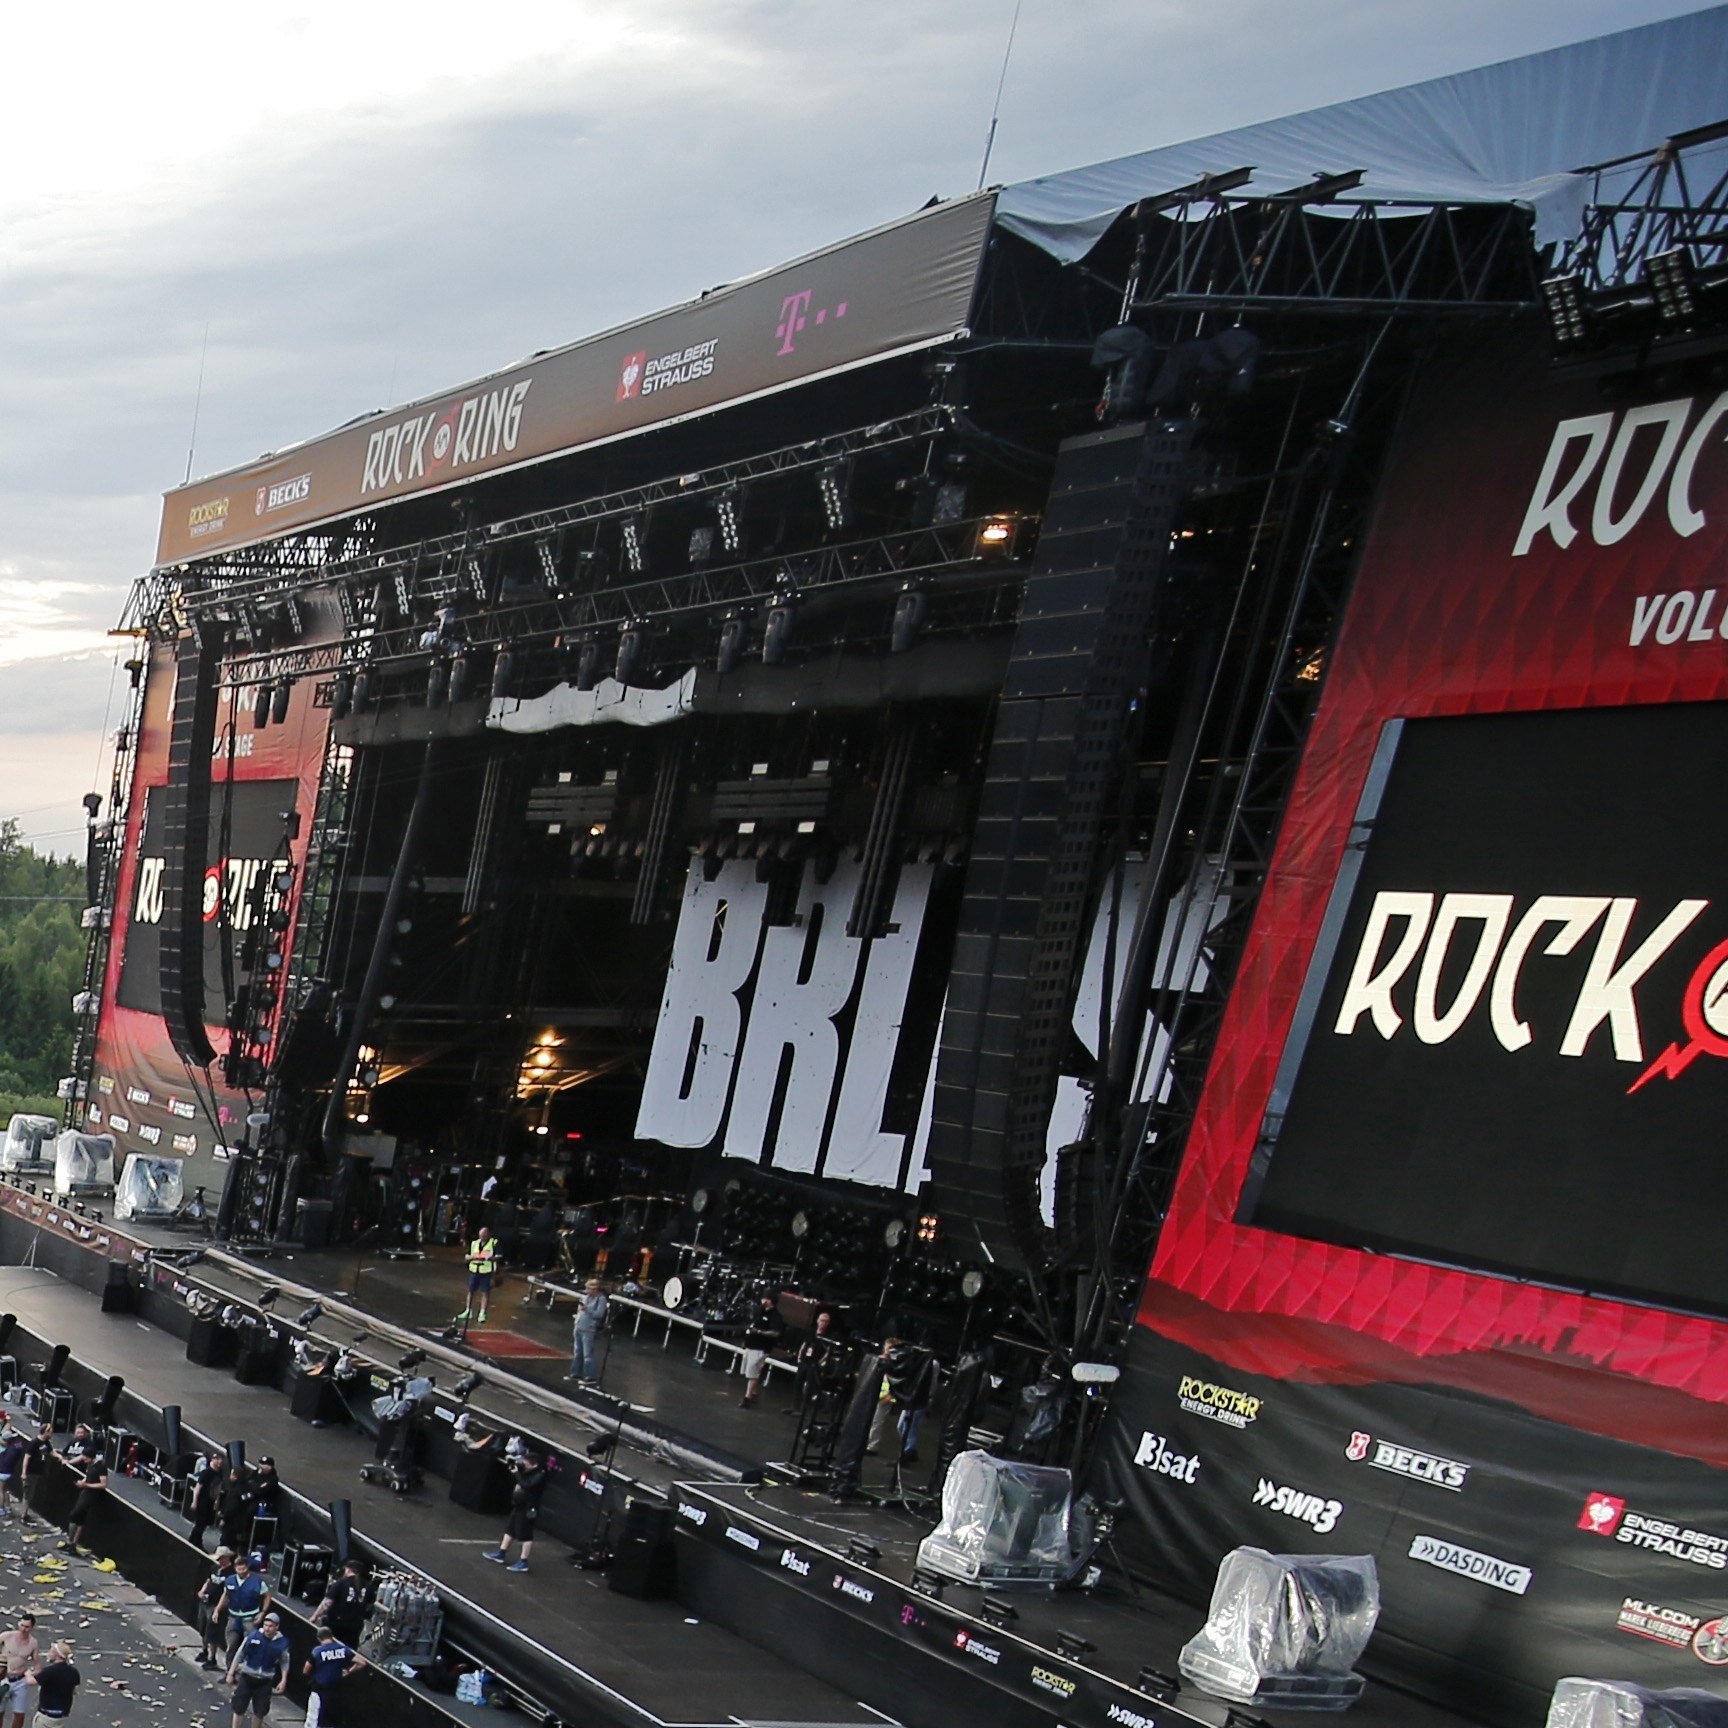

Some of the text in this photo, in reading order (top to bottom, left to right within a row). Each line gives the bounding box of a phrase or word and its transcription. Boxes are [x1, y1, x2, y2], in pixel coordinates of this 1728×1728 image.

[645, 337, 718, 373] ENGELBERT
[641, 357, 714, 396] STRAUSS
[361, 411, 436, 495] ROCK
[452, 379, 532, 468] RING
[268, 475, 311, 509] BECK'S
[189, 497, 229, 527] ROCKSTAR
[1333, 890, 1710, 1063] ROCK
[1179, 1375, 1260, 1419] ROCKSTAR
[1180, 1398, 1247, 1428] ENERGY DRINK
[1372, 1443, 1469, 1488] BECK'S
[1270, 1486, 1344, 1533] SWR3
[1615, 1527, 1727, 1569] STRAUSS
[1622, 1513, 1728, 1552] ENGELBERT
[1435, 1546, 1521, 1586] DASDING
[1623, 1597, 1700, 1629] MLK.COM
[1031, 1666, 1076, 1695] ROCKSTAR
